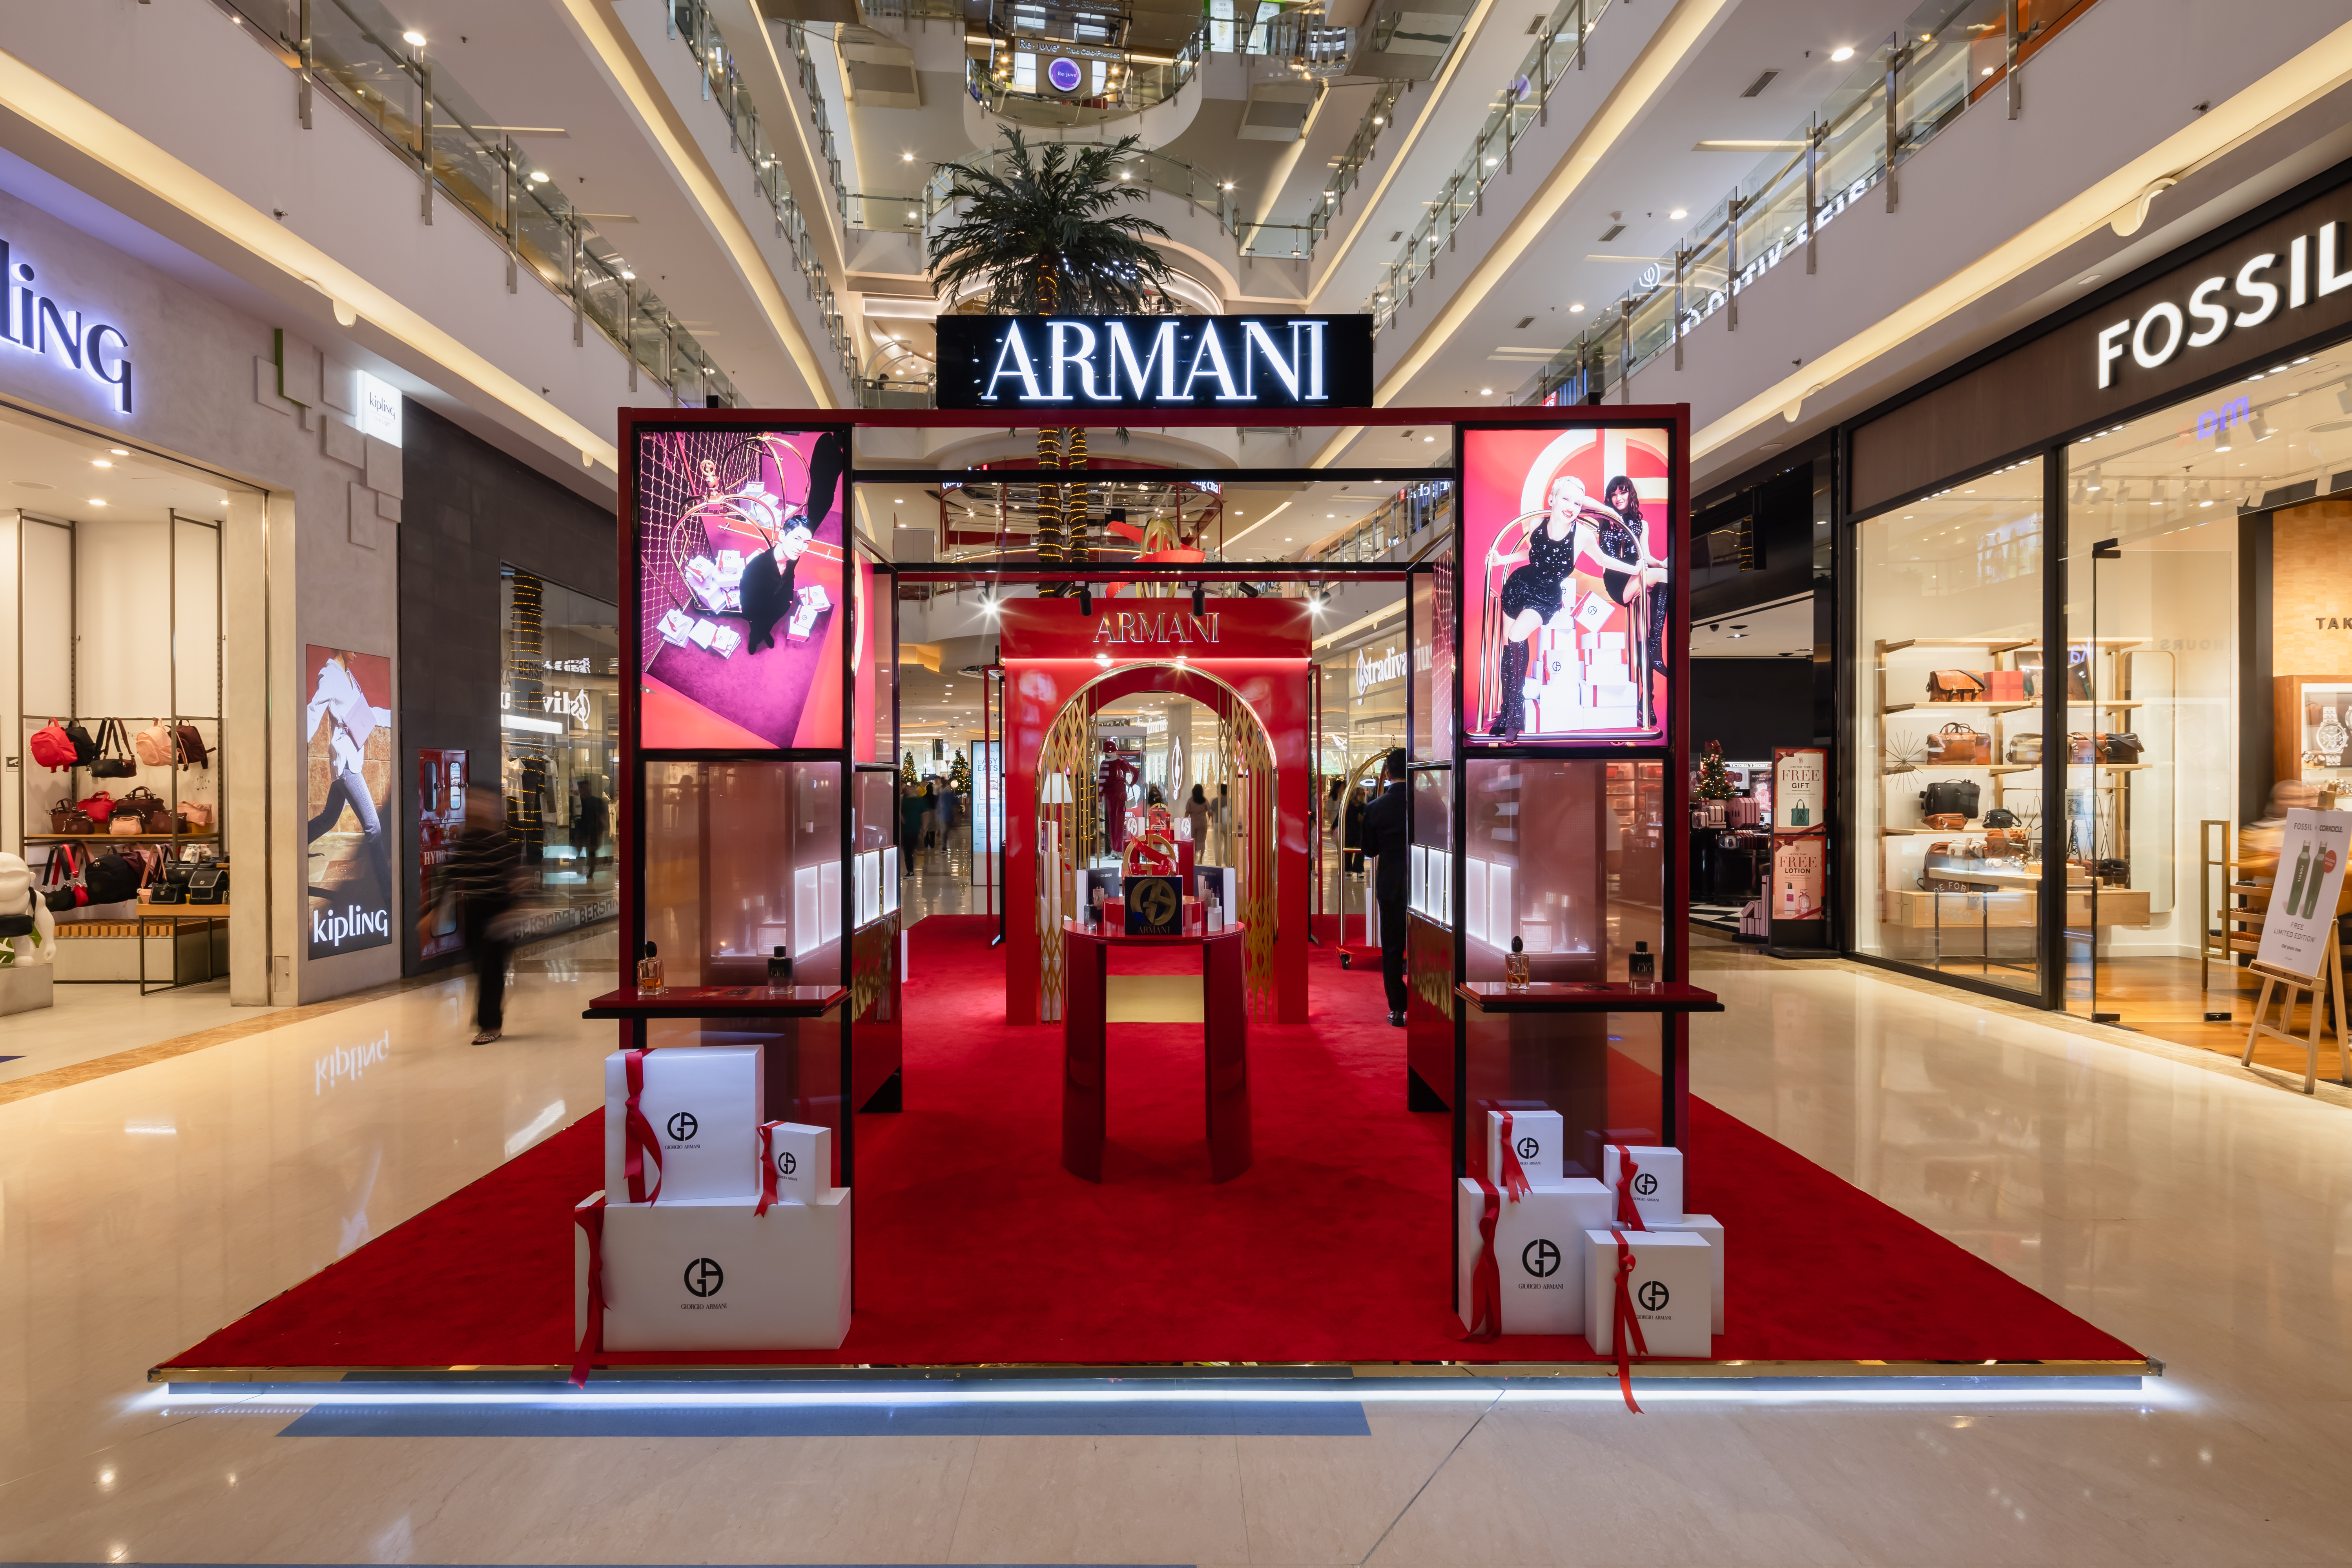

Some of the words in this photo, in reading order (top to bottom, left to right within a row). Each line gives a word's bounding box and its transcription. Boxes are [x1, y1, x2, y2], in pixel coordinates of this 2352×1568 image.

[685, 11, 689, 22] 1
[1081, 48, 1120, 58] Cold-Pressed
[2098, 221, 2352, 390] FOSSIL
[981, 319, 1329, 401] ARMANI
[370, 391, 395, 420] kipling
[382, 418, 390, 427] Light
[1207, 481, 1218, 494] cha
[1093, 612, 1220, 643] ARMANI
[1781, 770, 1820, 781] FREE
[424, 850, 448, 865] HYDR
[1779, 857, 1817, 868] FREE
[1948, 882, 1967, 892] FOR
[580, 898, 619, 923] BERSHK
[1938, 907, 1973, 924] FOSSIL
[314, 904, 388, 946] kipling
[1138, 926, 1170, 934] ARMANI
[2290, 922, 2304, 930] FREE
[2274, 928, 2294, 937] LIMITED
